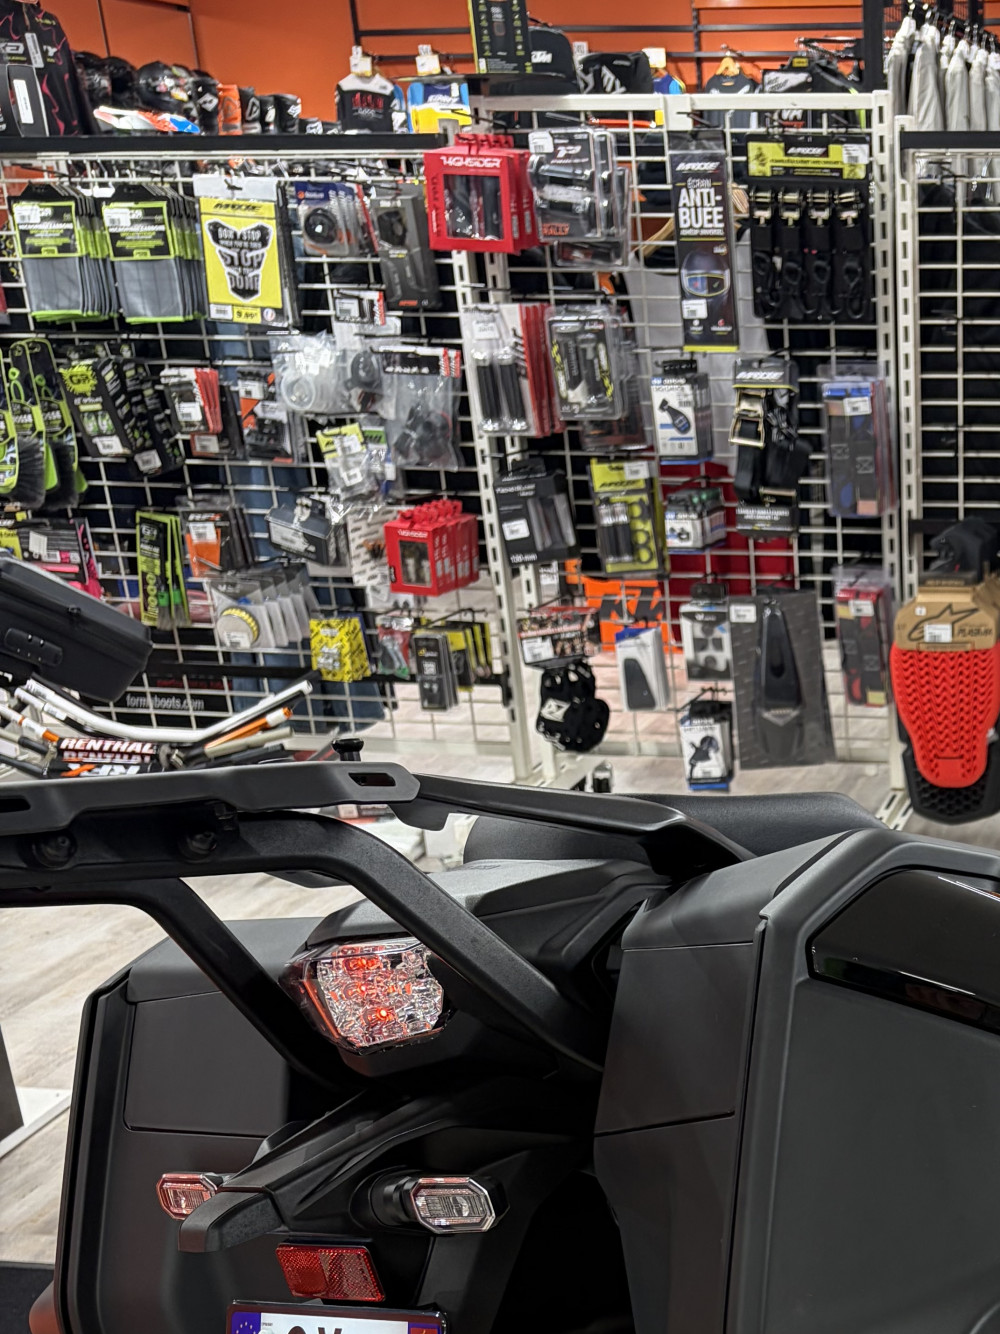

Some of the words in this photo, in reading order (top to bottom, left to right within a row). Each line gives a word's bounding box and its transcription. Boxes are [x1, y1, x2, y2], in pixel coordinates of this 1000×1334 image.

[678, 187, 722, 207] ANTI-
[678, 206, 725, 229] BUEE
[221, 248, 264, 267] STOP
[60, 737, 156, 755] RENTHAL
